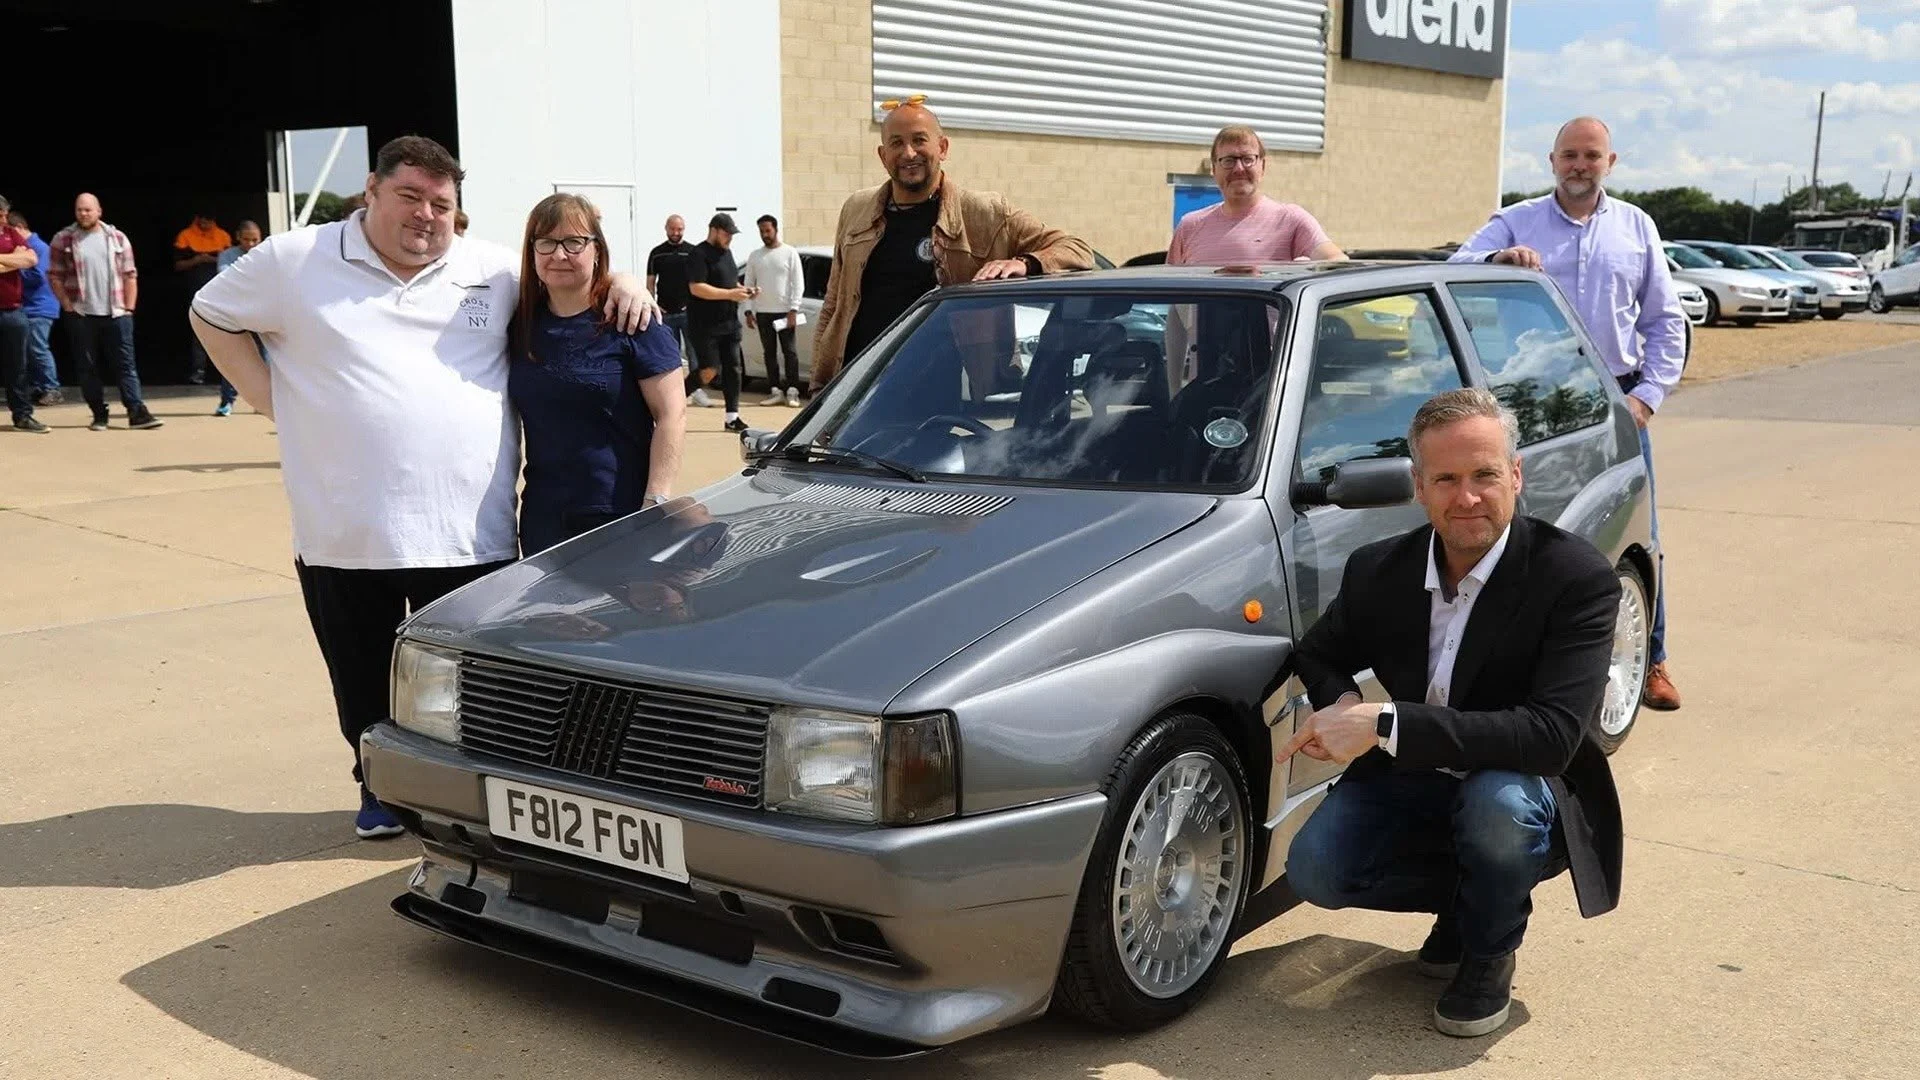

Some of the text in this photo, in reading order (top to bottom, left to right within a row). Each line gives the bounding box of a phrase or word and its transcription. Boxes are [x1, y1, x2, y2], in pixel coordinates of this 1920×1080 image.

[468, 316, 488, 327] NY
[506, 788, 665, 869] F812 FGN
